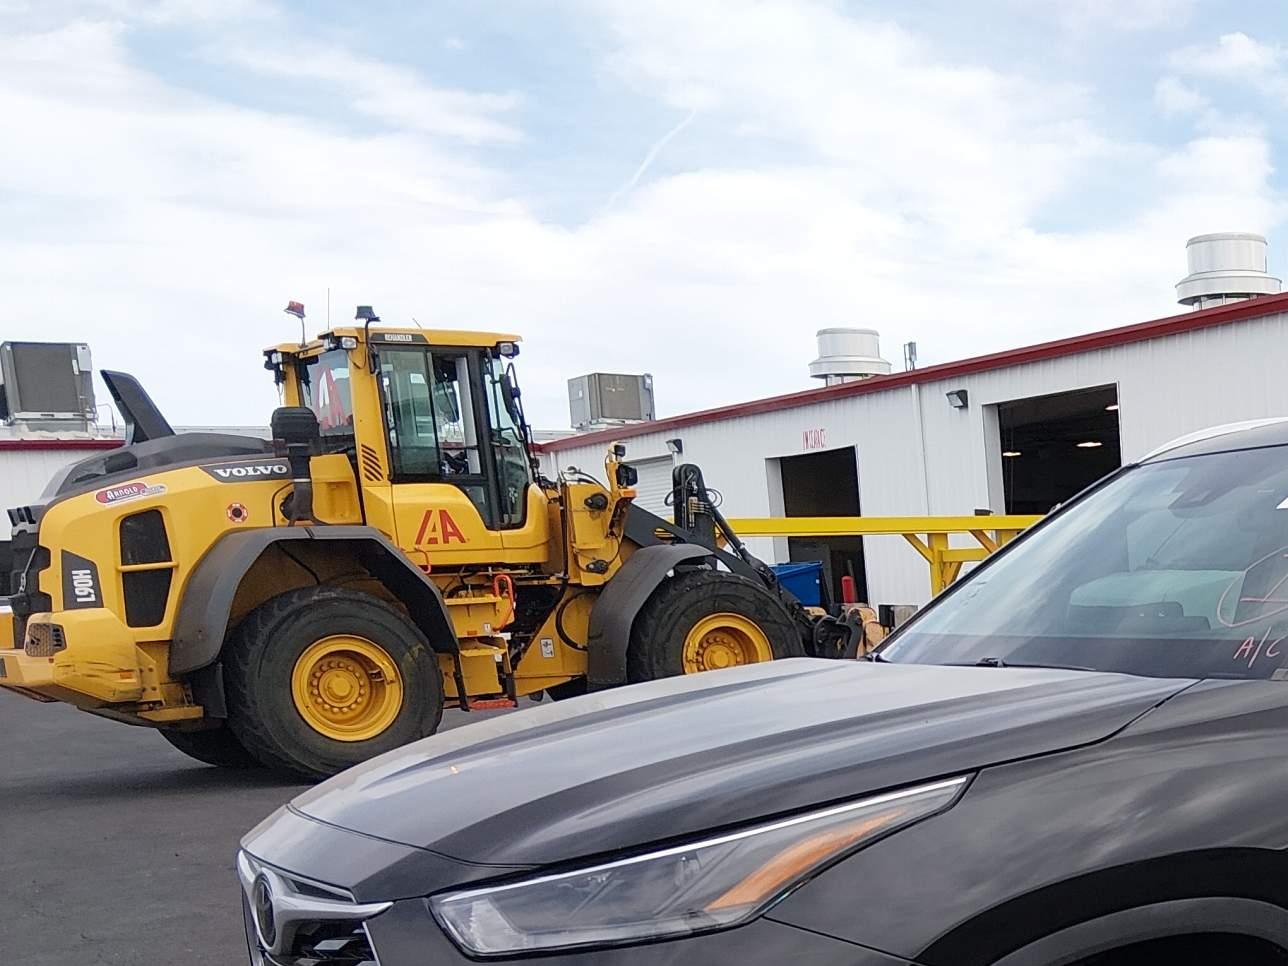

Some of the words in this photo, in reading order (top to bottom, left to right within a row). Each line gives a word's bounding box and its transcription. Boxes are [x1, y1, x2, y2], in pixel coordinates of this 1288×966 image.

[213, 464, 287, 478] VOLVO
[106, 486, 139, 500] ARNOLD
[72, 570, 96, 602] L90H
[1233, 626, 1282, 669] A/C
